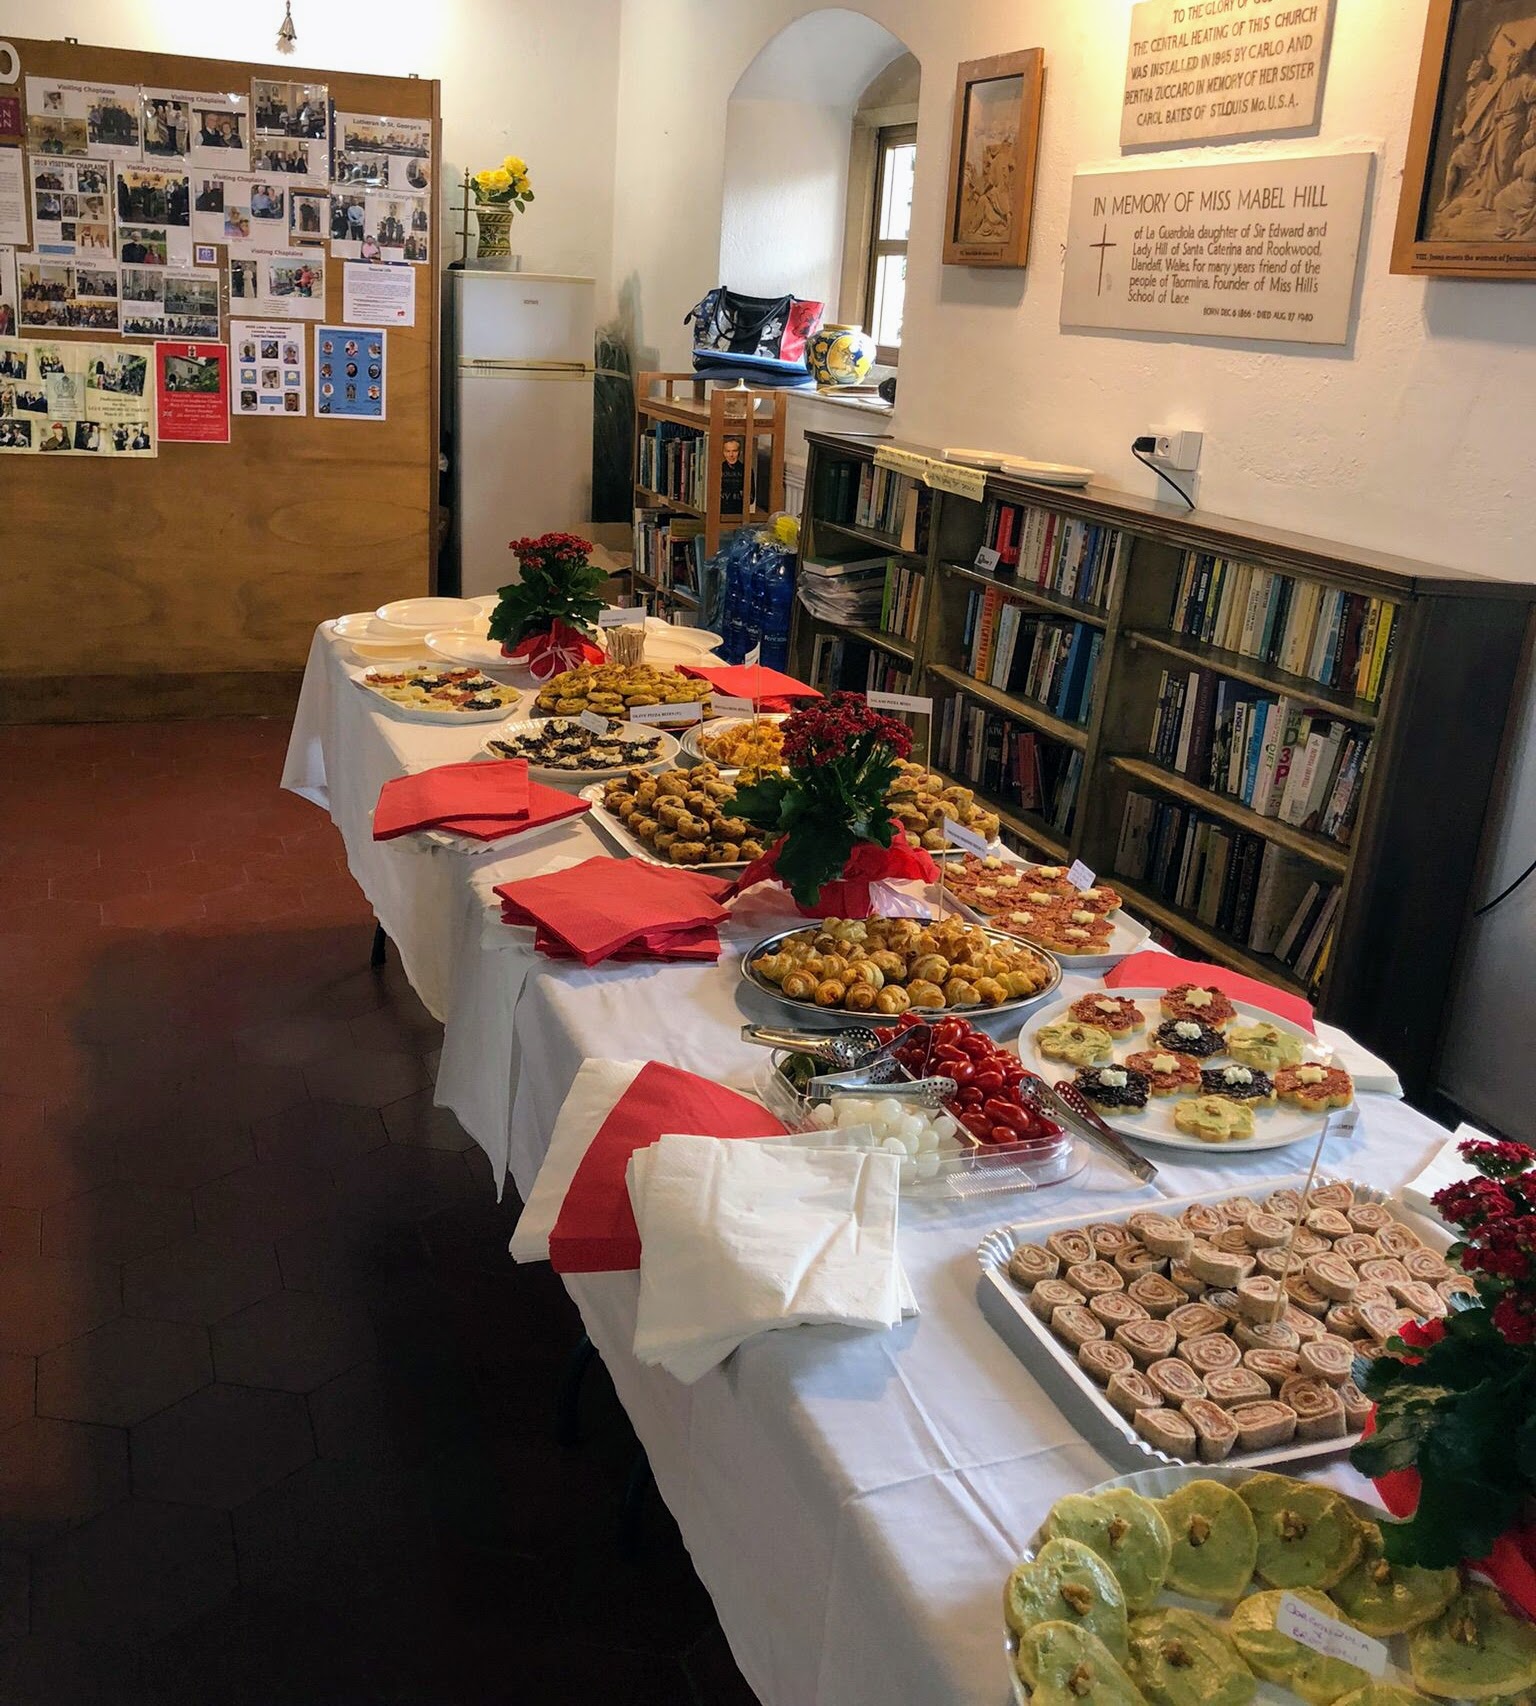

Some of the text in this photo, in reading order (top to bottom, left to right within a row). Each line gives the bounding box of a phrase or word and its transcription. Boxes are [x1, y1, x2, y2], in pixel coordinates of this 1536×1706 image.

[1173, 9, 1185, 23] TO
[1189, 4, 1204, 20] THE
[1133, 6, 1318, 57] THE CENTRAL HEATING OF THIS CHURCH
[1131, 65, 1148, 80] WAS
[1150, 56, 1199, 77] INSTALLED
[1201, 53, 1211, 69] IN
[1234, 47, 1248, 62] BY
[1249, 40, 1284, 59] CARLO
[1287, 35, 1313, 54] AND
[57, 83, 116, 95] Visiting Chaplains
[1125, 62, 1314, 105] BERTHA ZUCCARO IN MEMORY OF HER SISTER
[171, 94, 227, 105] Visiting Chaplains
[1136, 111, 1163, 126] CAROL
[1166, 107, 1192, 124] BATES
[1194, 105, 1206, 120] OF
[49, 160, 75, 168] VISITING
[76, 162, 108, 171] CHAPLAINS
[127, 164, 182, 174] Visiting Chaplains
[1093, 185, 1328, 216] IN MEMORY OF MISS MABEL HILL
[1134, 226, 1144, 240] of
[1146, 226, 1155, 240] La
[1197, 224, 1239, 243] daughter
[1241, 224, 1251, 240] of
[1253, 223, 1266, 238] Sir
[1268, 223, 1305, 238] Edward
[1307, 221, 1328, 238] and
[1133, 242, 1152, 259] Lady
[1155, 242, 1168, 256] Hill
[1170, 242, 1181, 256] of
[1182, 242, 1204, 256] Santa
[1207, 242, 1242, 256] Caterina
[1245, 241, 1263, 256] and
[1192, 258, 1205, 272] For
[1208, 262, 1231, 276] many
[1232, 262, 1256, 277] years
[1259, 258, 1288, 274] friend
[1290, 259, 1302, 274] of
[1304, 259, 1321, 275] the
[1129, 274, 1157, 289] people
[1159, 274, 1169, 288] of
[1212, 275, 1251, 291] Founder
[1253, 276, 1266, 291] of
[1269, 277, 1292, 293] Miss
[1128, 289, 1189, 304] School of Lace
[1203, 307, 1220, 317] BORN
[1256, 310, 1272, 320] DIED
[1235, 707, 1244, 734] TINSEL
